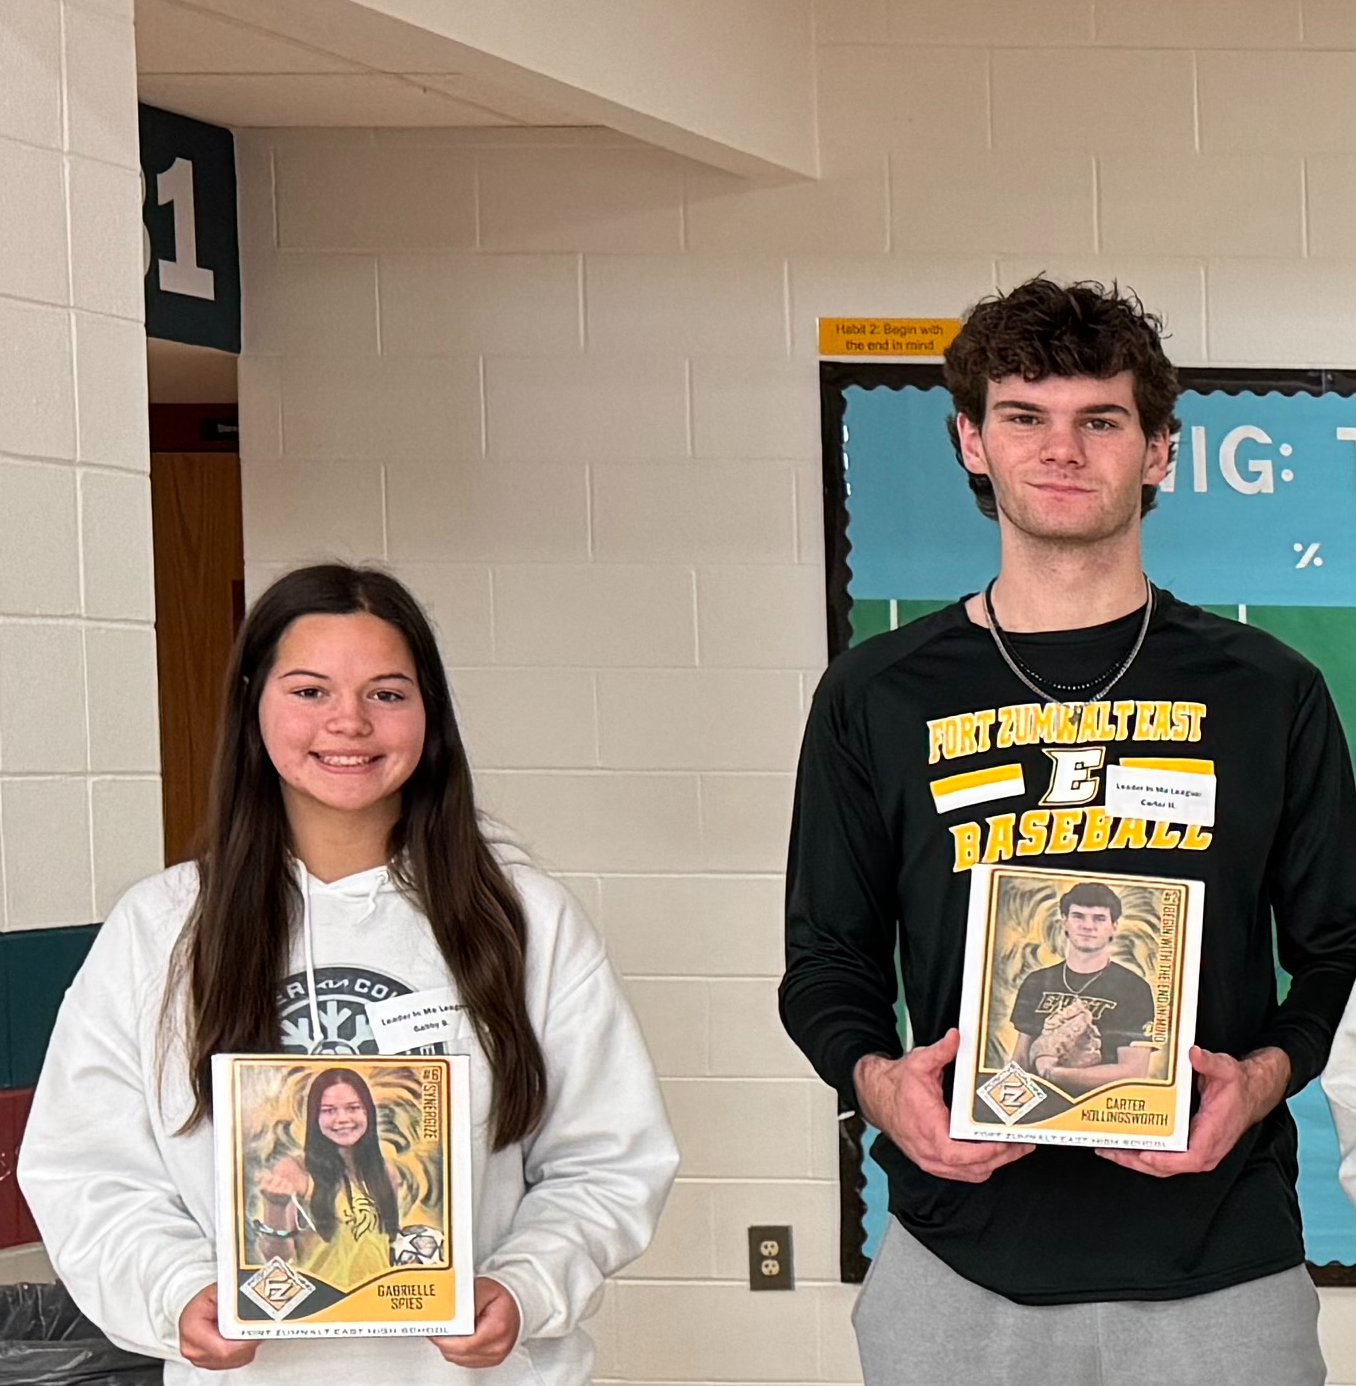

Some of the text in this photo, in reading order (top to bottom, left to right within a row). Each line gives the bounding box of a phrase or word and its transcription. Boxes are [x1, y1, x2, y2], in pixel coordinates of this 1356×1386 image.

[140, 157, 216, 301] 1
[836, 324, 866, 335] Habit
[884, 324, 917, 337] Begin
[920, 324, 943, 335] with
[846, 340, 934, 351] the end in mind
[1293, 541, 1324, 570] %
[926, 700, 1207, 764] FORT ZUMWALT EAST
[1038, 746, 1106, 806] E
[948, 806, 1213, 872] BASEBALL
[422, 1069, 439, 1081] #6
[423, 1084, 438, 1139] SYNERGIZE
[1106, 1097, 1146, 1111] CARTER
[1081, 1110, 1168, 1126] HOLLINGSWORTH
[377, 1284, 436, 1297] GABRIELLE
[391, 1297, 423, 1310] SPIES
